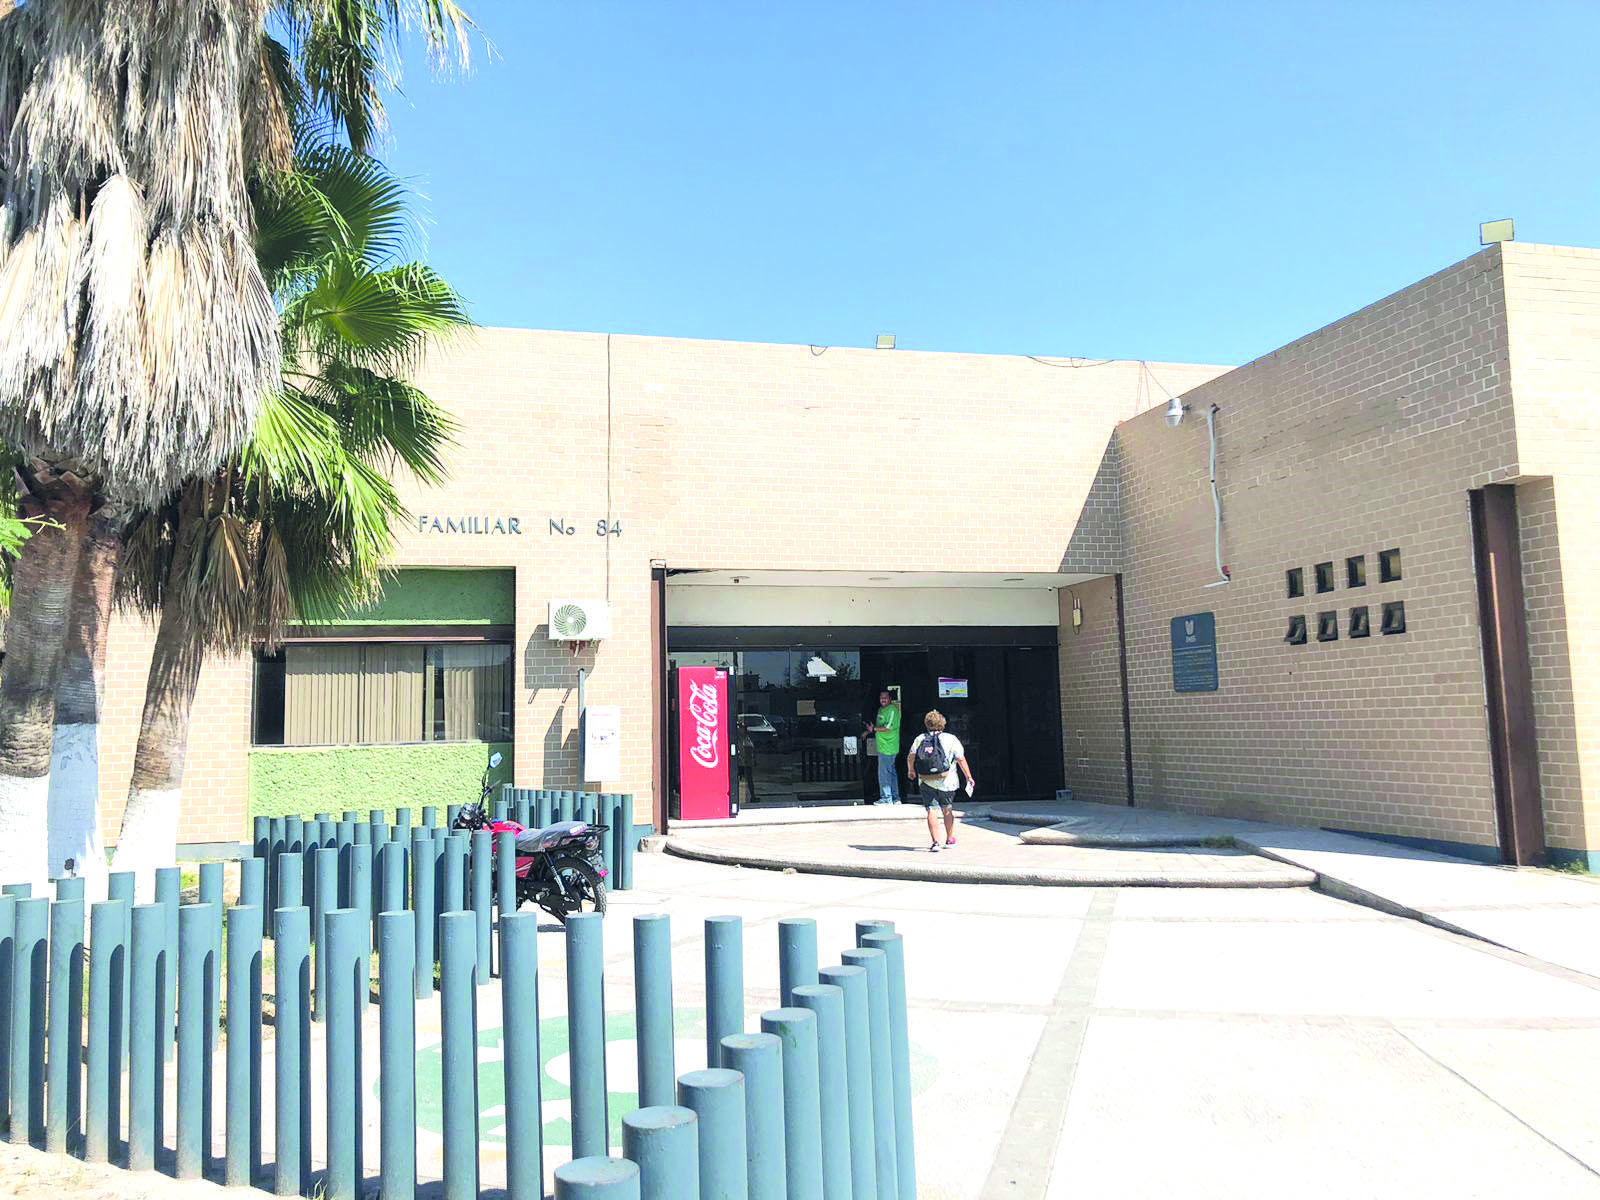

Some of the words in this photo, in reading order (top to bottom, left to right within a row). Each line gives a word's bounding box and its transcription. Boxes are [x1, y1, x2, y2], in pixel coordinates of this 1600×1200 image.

[418, 515, 522, 535] FAMILIAR
[549, 518, 575, 536] No
[596, 519, 622, 537] 84
